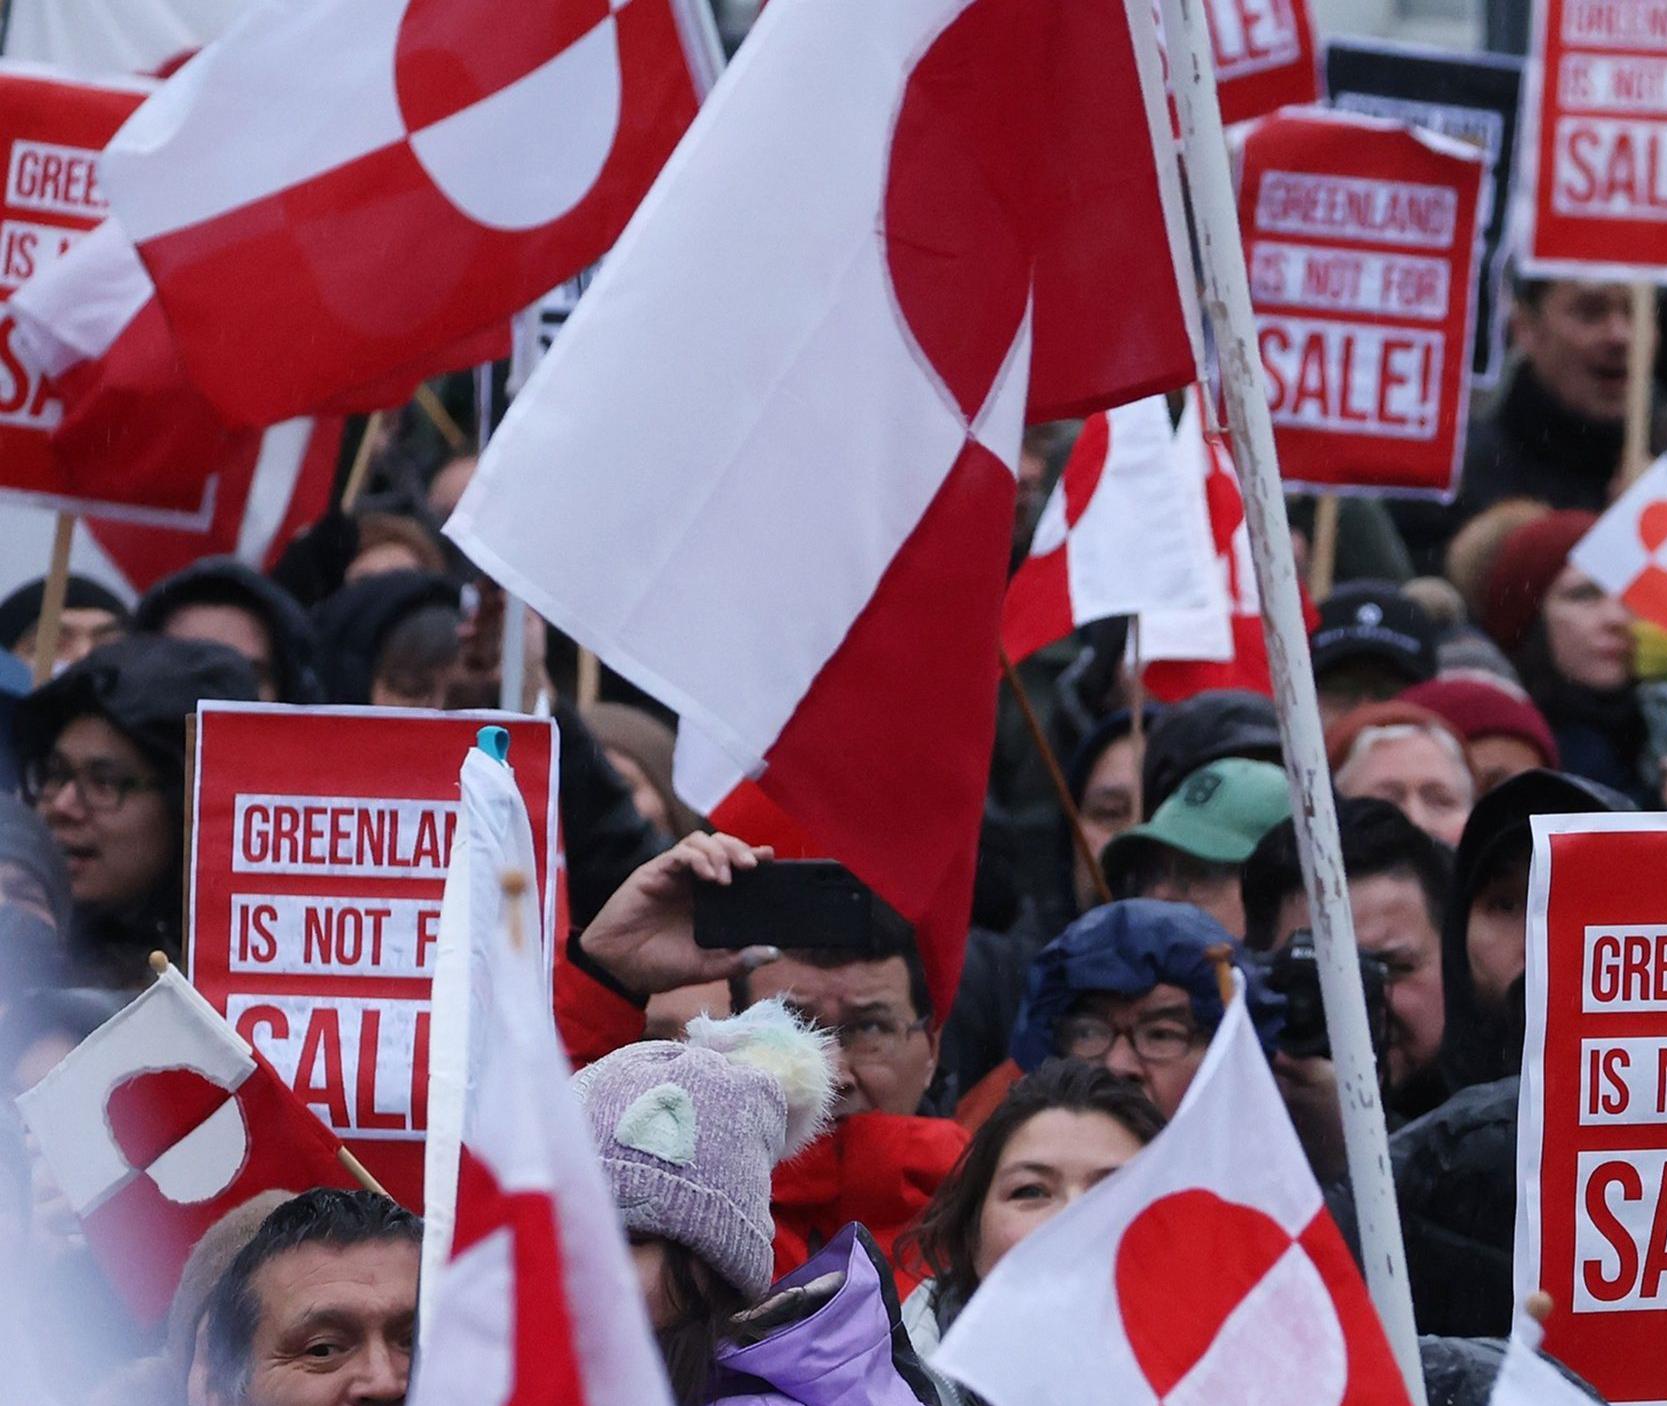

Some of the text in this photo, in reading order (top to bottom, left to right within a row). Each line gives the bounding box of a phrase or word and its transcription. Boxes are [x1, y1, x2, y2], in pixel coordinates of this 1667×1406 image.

[4, 232, 38, 279] IS
[1257, 326, 1434, 428] SALE!
[242, 804, 458, 868] GREENLA
[238, 904, 278, 963] IS
[304, 907, 391, 966] NOT
[1589, 1048, 1630, 1115] IS
